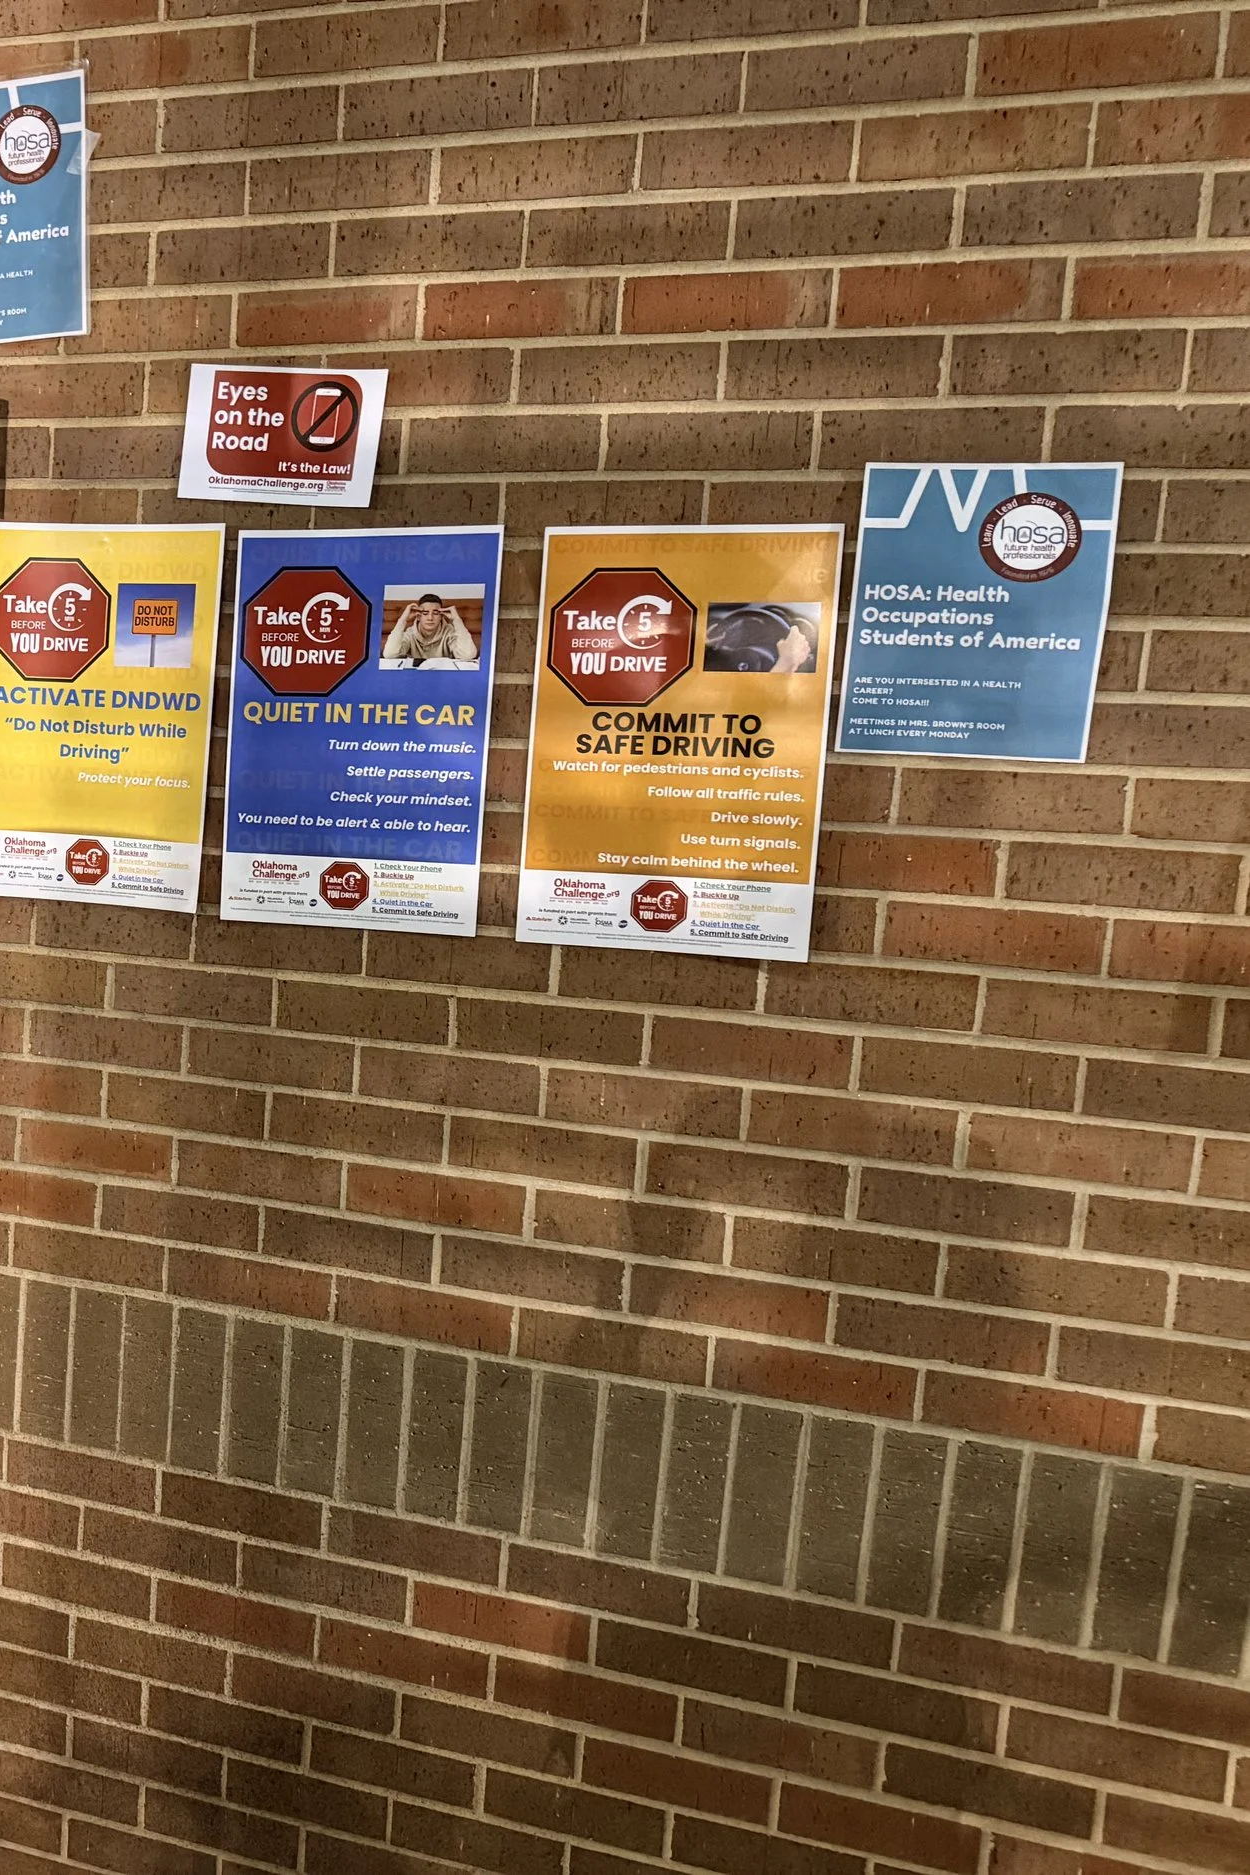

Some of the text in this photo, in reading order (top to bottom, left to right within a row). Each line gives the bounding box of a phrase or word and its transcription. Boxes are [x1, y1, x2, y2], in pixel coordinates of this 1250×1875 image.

[6, 224, 69, 243] America
[217, 382, 268, 405] Eyes
[214, 408, 284, 426] on the
[212, 432, 269, 451] Road
[278, 461, 351, 475] It's the Law!
[208, 476, 324, 492] OklahomaChallenge.org
[864, 584, 1010, 603] HOSA: Health
[3, 595, 76, 615] Take 5
[138, 606, 173, 615] DO NOT
[11, 620, 46, 629] BEFORE
[135, 617, 174, 627] DISTURB
[254, 606, 332, 626] Take 5
[563, 610, 651, 632] Take 5
[862, 607, 994, 627] Occupations
[10, 633, 88, 654] YOU DRIVE
[262, 633, 299, 642] BEFORE
[572, 638, 614, 648] BEFORE
[859, 629, 1081, 651] Students of America
[261, 646, 345, 667] YOU DRIVE
[570, 652, 667, 675] YOU DRIVE
[853, 687, 893, 695] CAREER?
[983, 681, 1021, 689] HEALTH
[112, 691, 201, 711] DNDWD
[243, 701, 475, 726] QUIET IN THE CAR
[592, 711, 762, 735] COMMIT TO
[5, 717, 187, 738] "Do Not Disturb While
[850, 718, 895, 726] MEETINGS
[933, 721, 974, 729] BROWN'S
[929, 731, 970, 739] MONDAY
[60, 744, 129, 764] Driving"
[329, 739, 476, 754] Turn down the music.
[576, 734, 775, 758] SAFE DRIVING
[347, 766, 474, 782] Settle passengers.
[553, 760, 804, 780] Watch for pedestrians and cyclists.
[78, 772, 190, 789] Protect your focus.
[330, 791, 472, 807] Check your mindset.
[648, 786, 804, 802] Follow all traffic rules.
[238, 813, 471, 834] You need to be alert & able to hear.
[710, 811, 802, 829] Drive slowly.
[681, 833, 800, 851] Use turn signals.
[598, 852, 798, 874] Stay calm behind the wheel.
